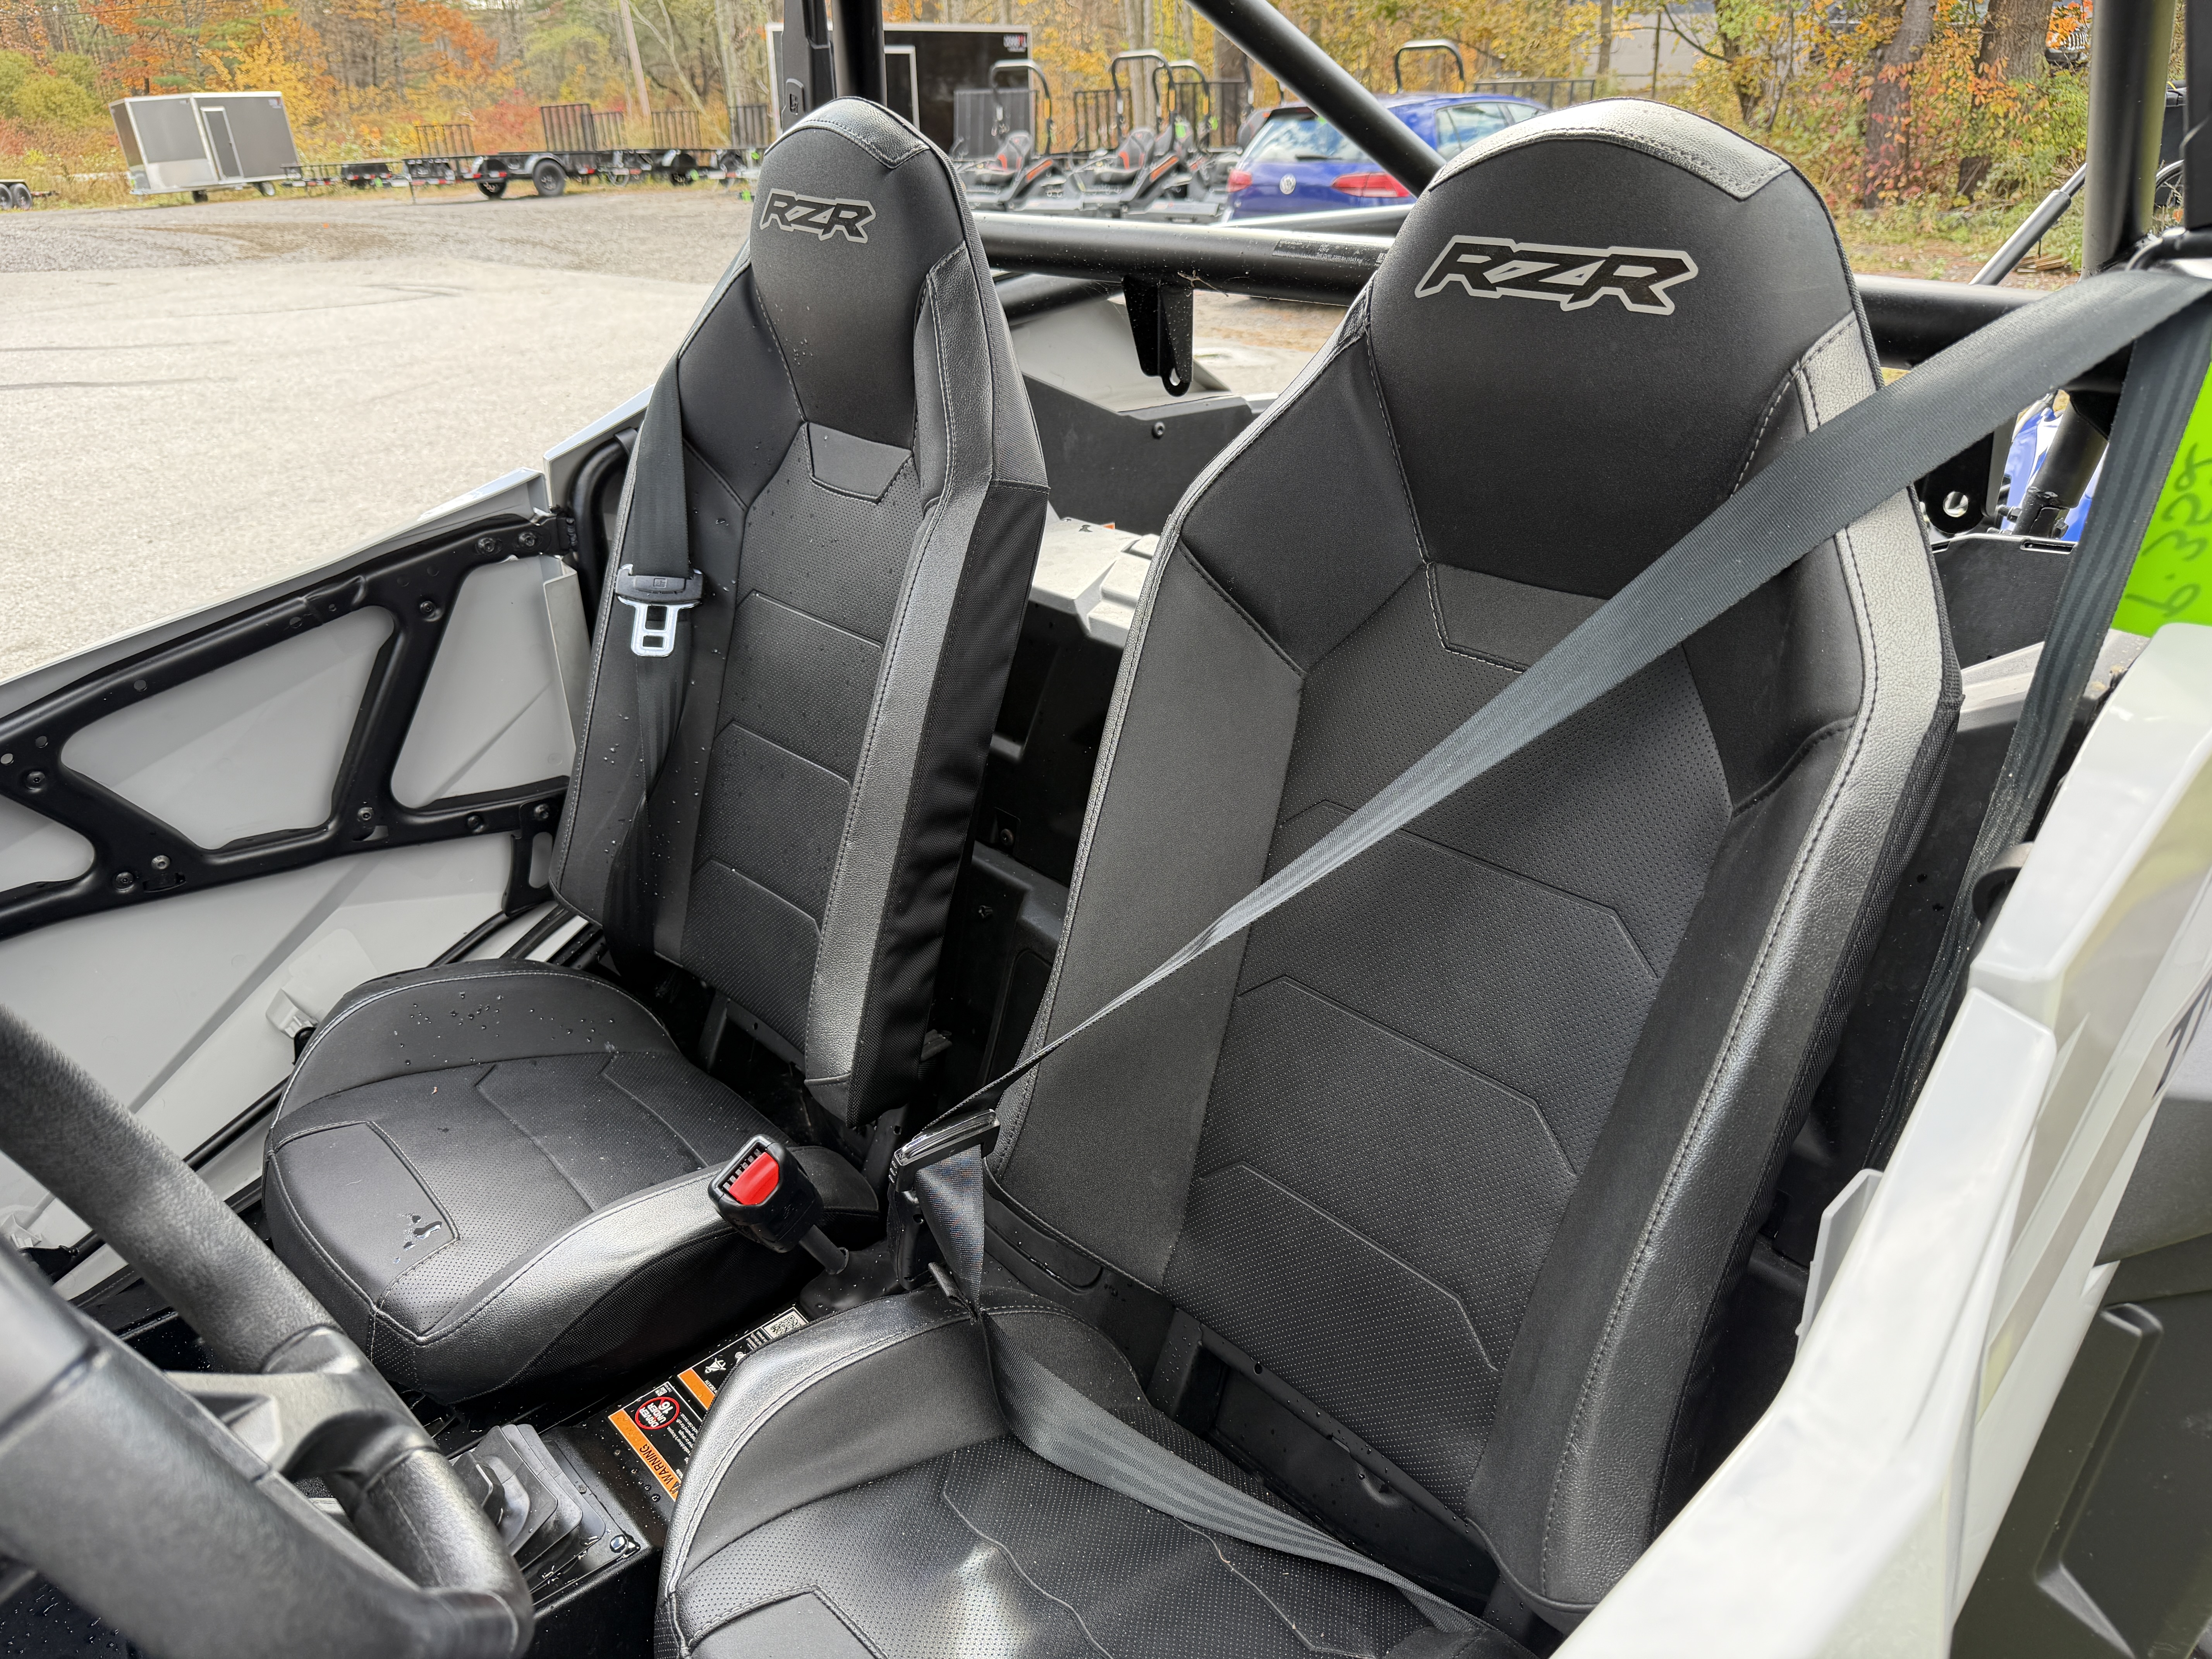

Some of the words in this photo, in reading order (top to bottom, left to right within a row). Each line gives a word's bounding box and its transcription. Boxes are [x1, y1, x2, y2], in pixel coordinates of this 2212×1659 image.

[760, 188, 876, 243] RZR
[1415, 235, 1698, 315] RZR
[704, 1379, 716, 1391] DEATH
[639, 1407, 659, 1428] DRIVER
[647, 1403, 666, 1423] UNDER
[658, 1401, 673, 1414] 16
[639, 1443, 674, 1485] WARNING
